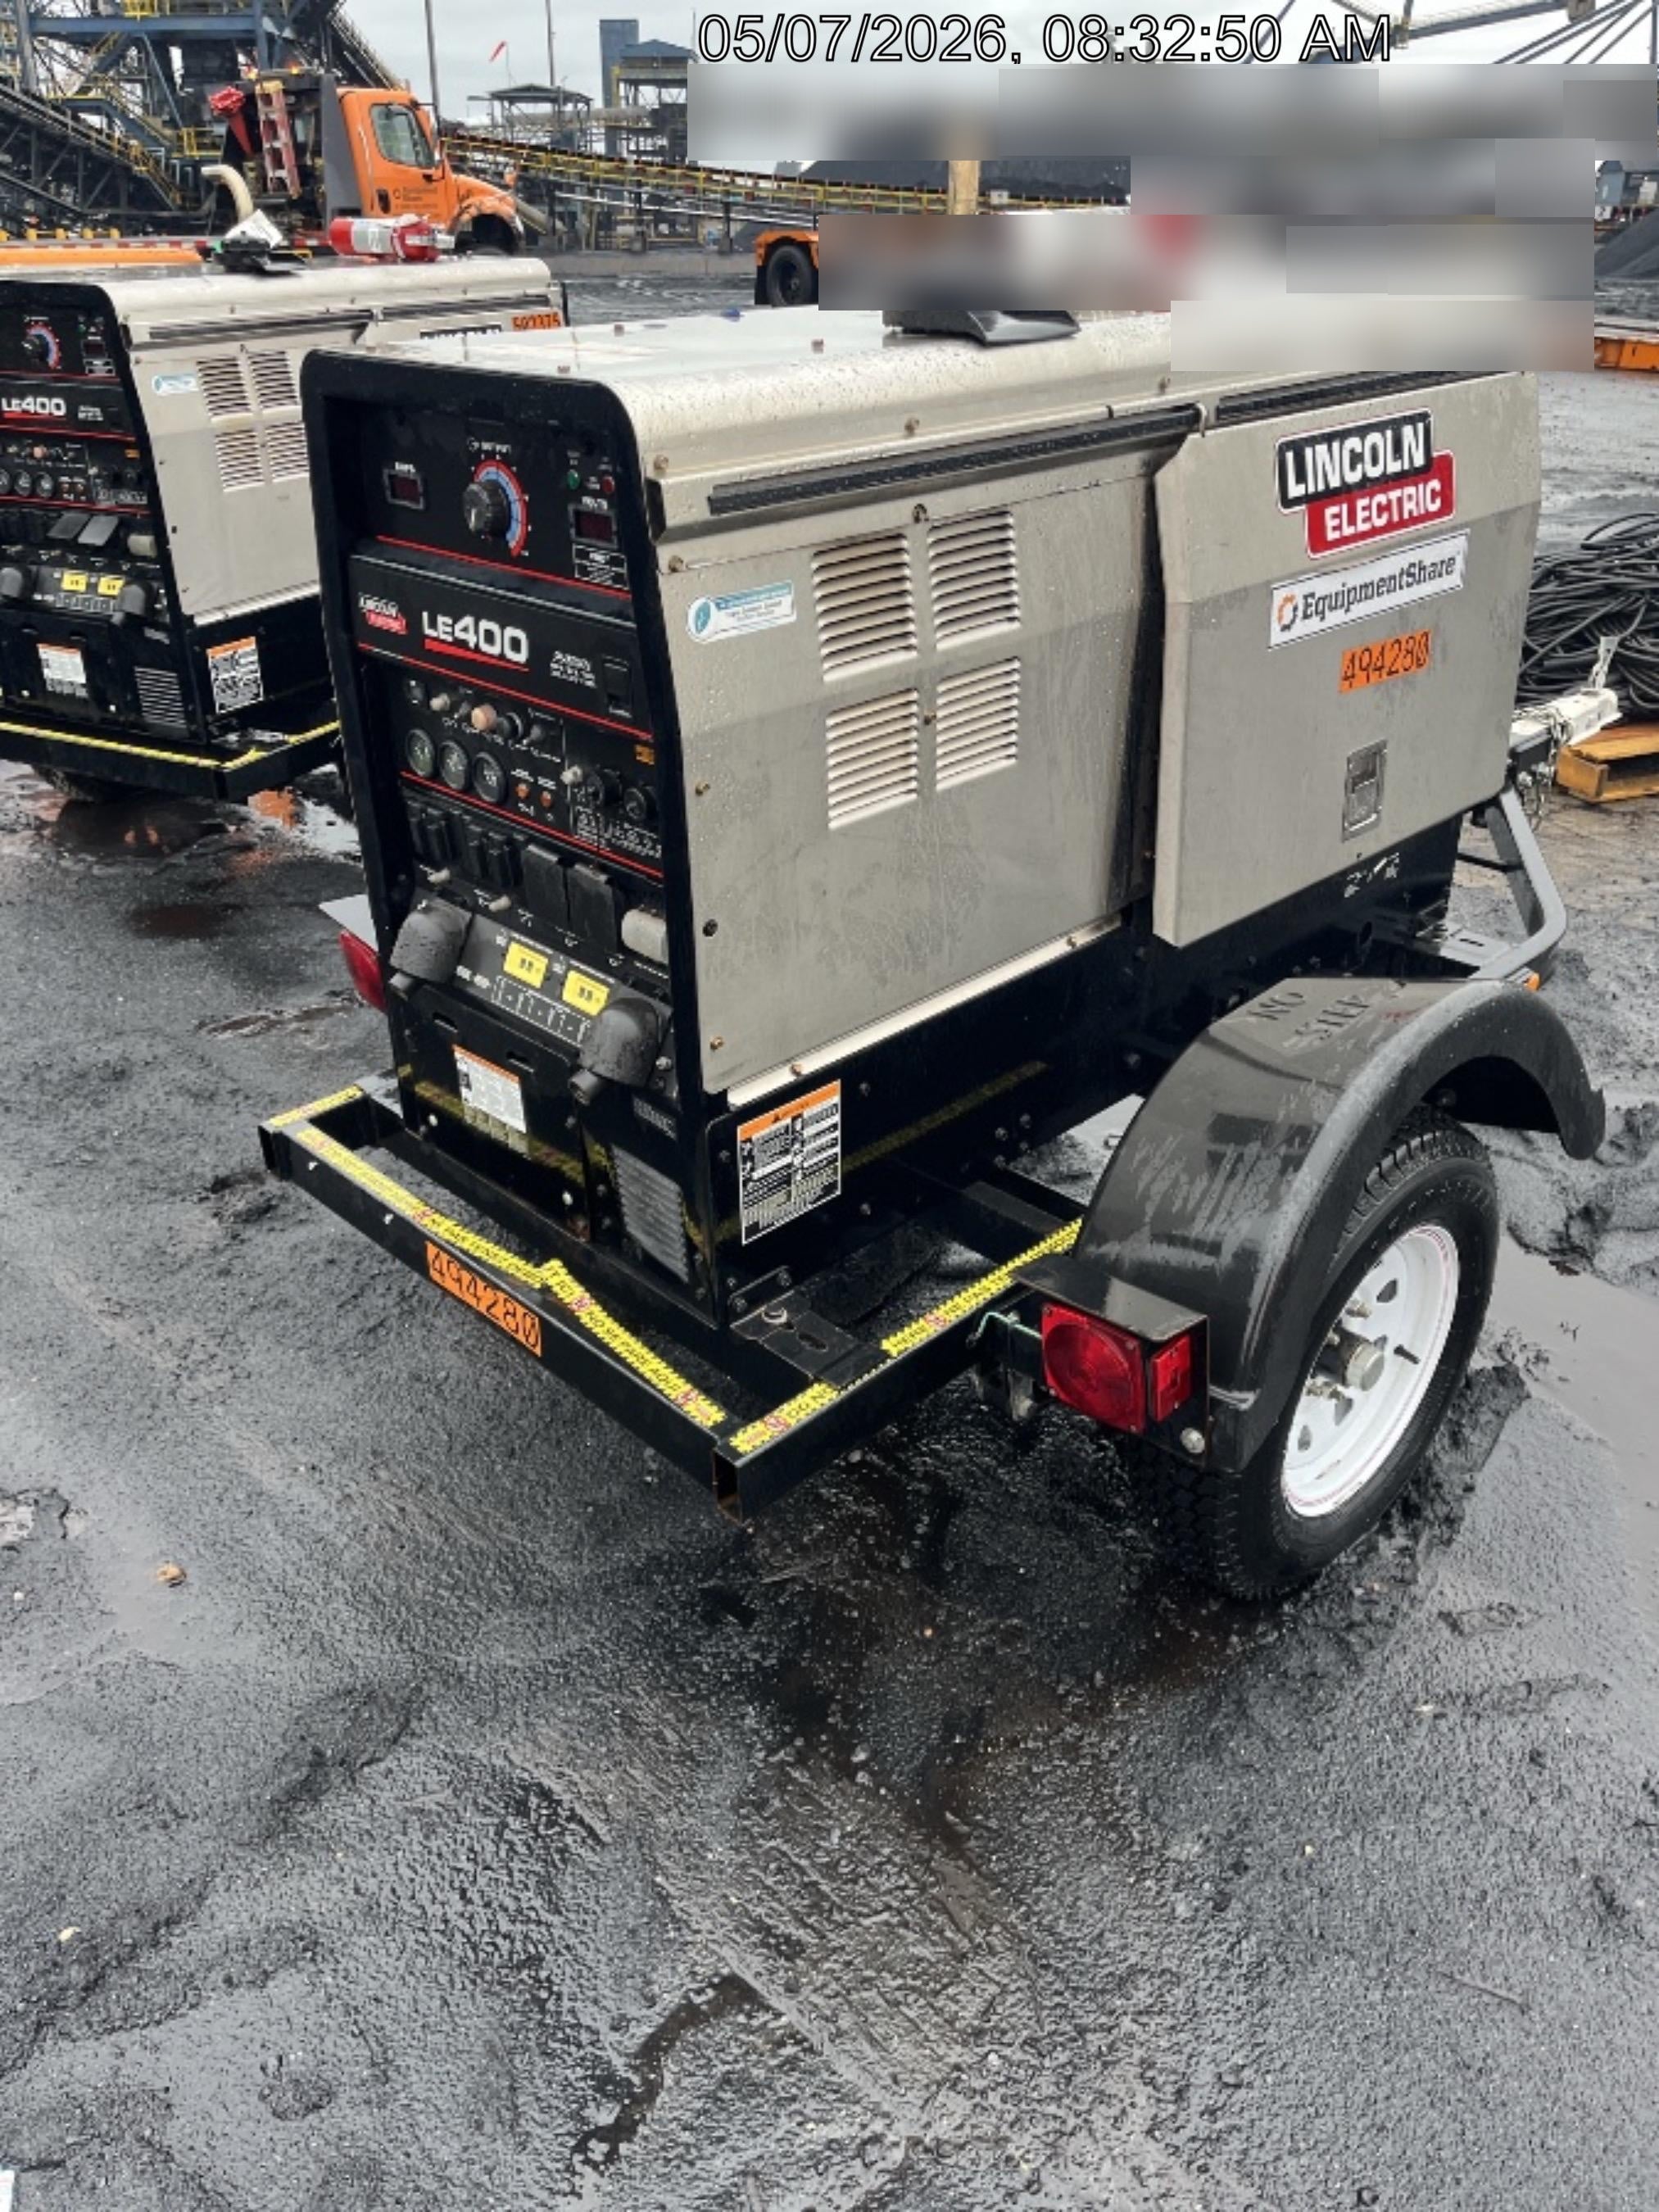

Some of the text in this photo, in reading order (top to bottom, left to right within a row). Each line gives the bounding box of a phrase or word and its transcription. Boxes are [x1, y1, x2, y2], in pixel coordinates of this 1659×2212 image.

[1285, 423, 1424, 499] LINCOLN
[1325, 479, 1441, 542] ELECTRIC
[1301, 556, 1457, 622] EquipmentShare
[422, 611, 529, 664] LE400
[1342, 632, 1430, 688] 494280
[433, 1250, 539, 1349] 494280
